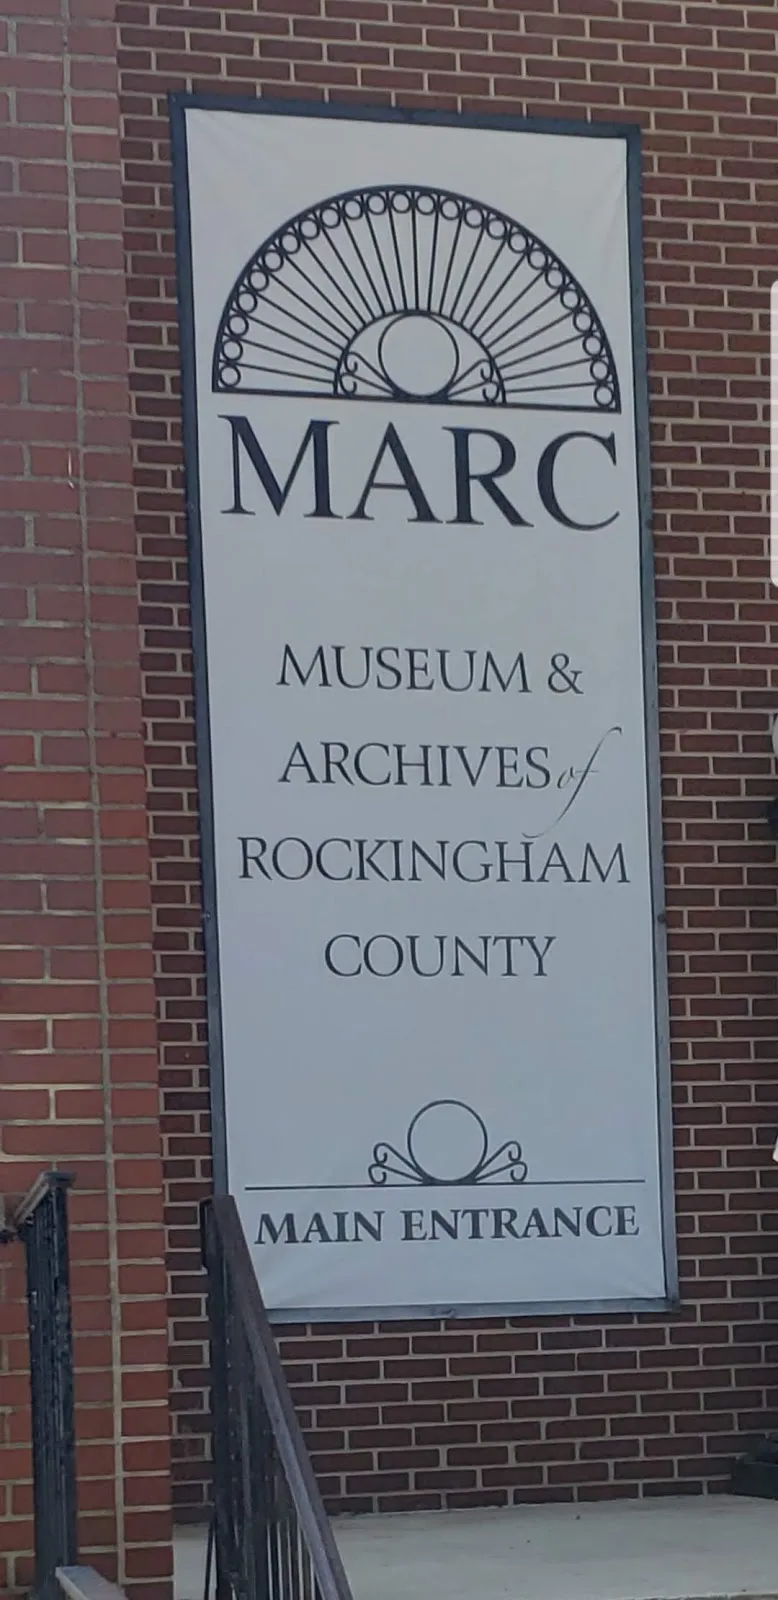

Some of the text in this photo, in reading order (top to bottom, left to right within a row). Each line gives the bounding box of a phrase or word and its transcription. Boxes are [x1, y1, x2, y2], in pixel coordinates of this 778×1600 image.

[217, 414, 621, 532] MARC
[275, 643, 585, 695] MUSEUM &
[277, 726, 623, 839] ARCHIVES of
[237, 836, 631, 884] ROCKINGHAM
[324, 933, 557, 978] COUNTY
[254, 1205, 640, 1245] MAIN ENTRANCE
